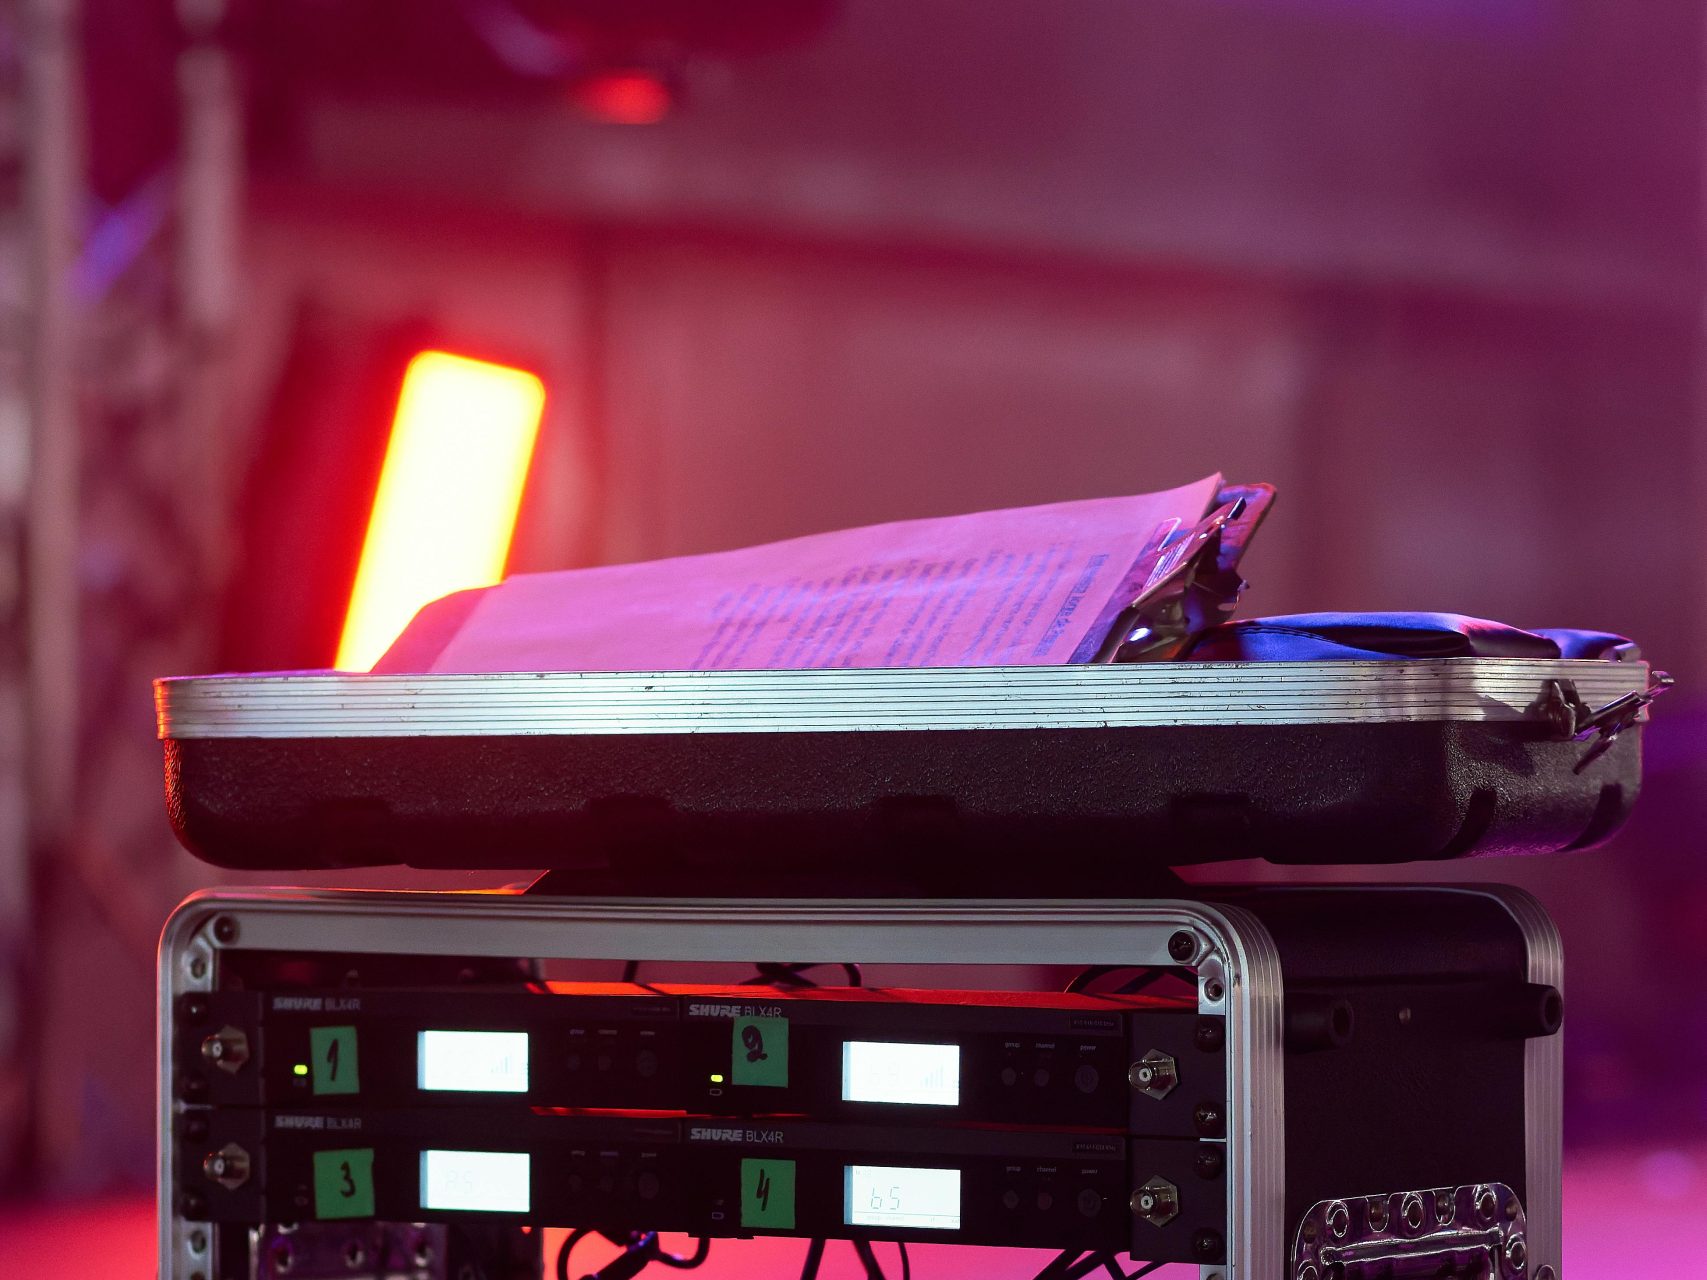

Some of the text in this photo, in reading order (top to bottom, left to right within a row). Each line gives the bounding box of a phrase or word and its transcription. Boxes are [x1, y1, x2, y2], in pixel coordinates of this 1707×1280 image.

[273, 996, 322, 1011] SHURE
[689, 1003, 742, 1017] SHURE
[274, 1114, 324, 1130] SHURE
[690, 1127, 784, 1144] SHURE BLX4R
[339, 1160, 357, 1199] 3
